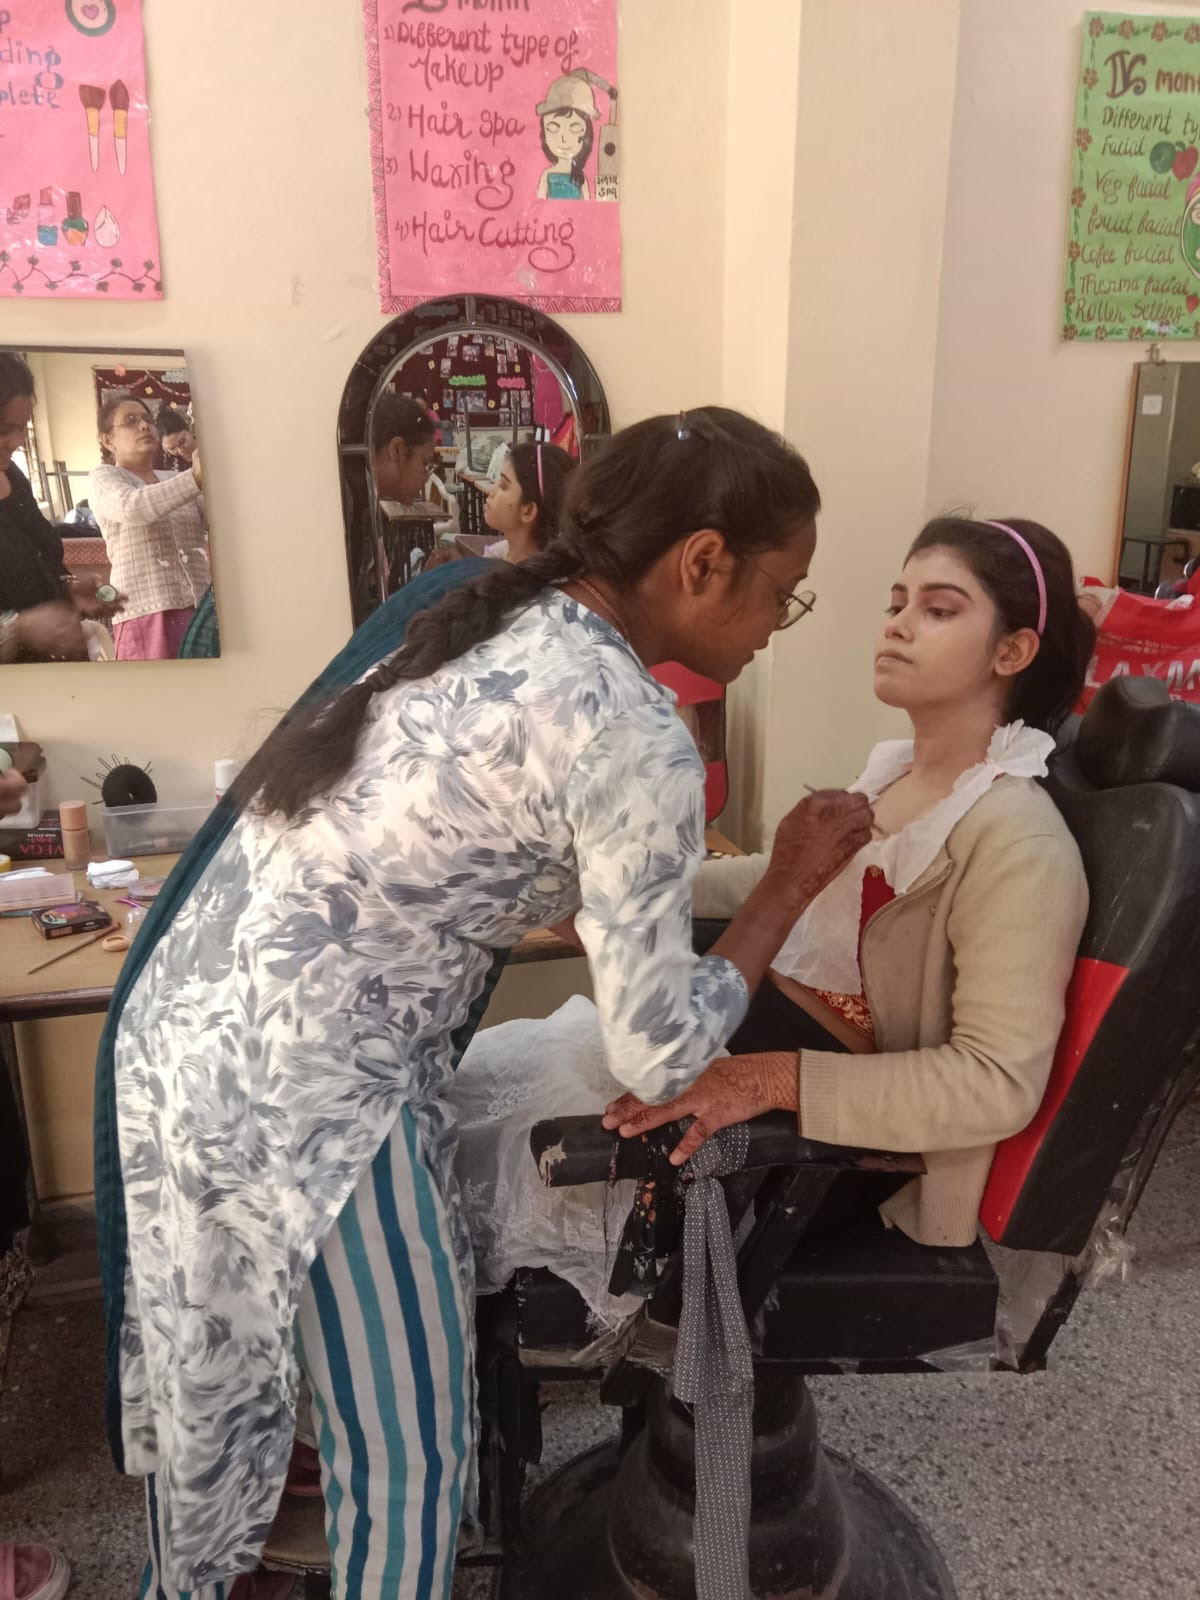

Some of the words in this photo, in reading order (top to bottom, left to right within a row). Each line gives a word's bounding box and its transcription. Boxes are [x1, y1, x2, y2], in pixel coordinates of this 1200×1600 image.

[501, 23, 551, 67] type
[554, 30, 580, 75] of
[408, 101, 473, 139] Hair
[1183, 112, 1200, 145] ty
[409, 149, 516, 212] Waxing
[1096, 169, 1122, 206] Veg
[412, 209, 475, 257] Hair
[478, 217, 575, 274] Cutting
